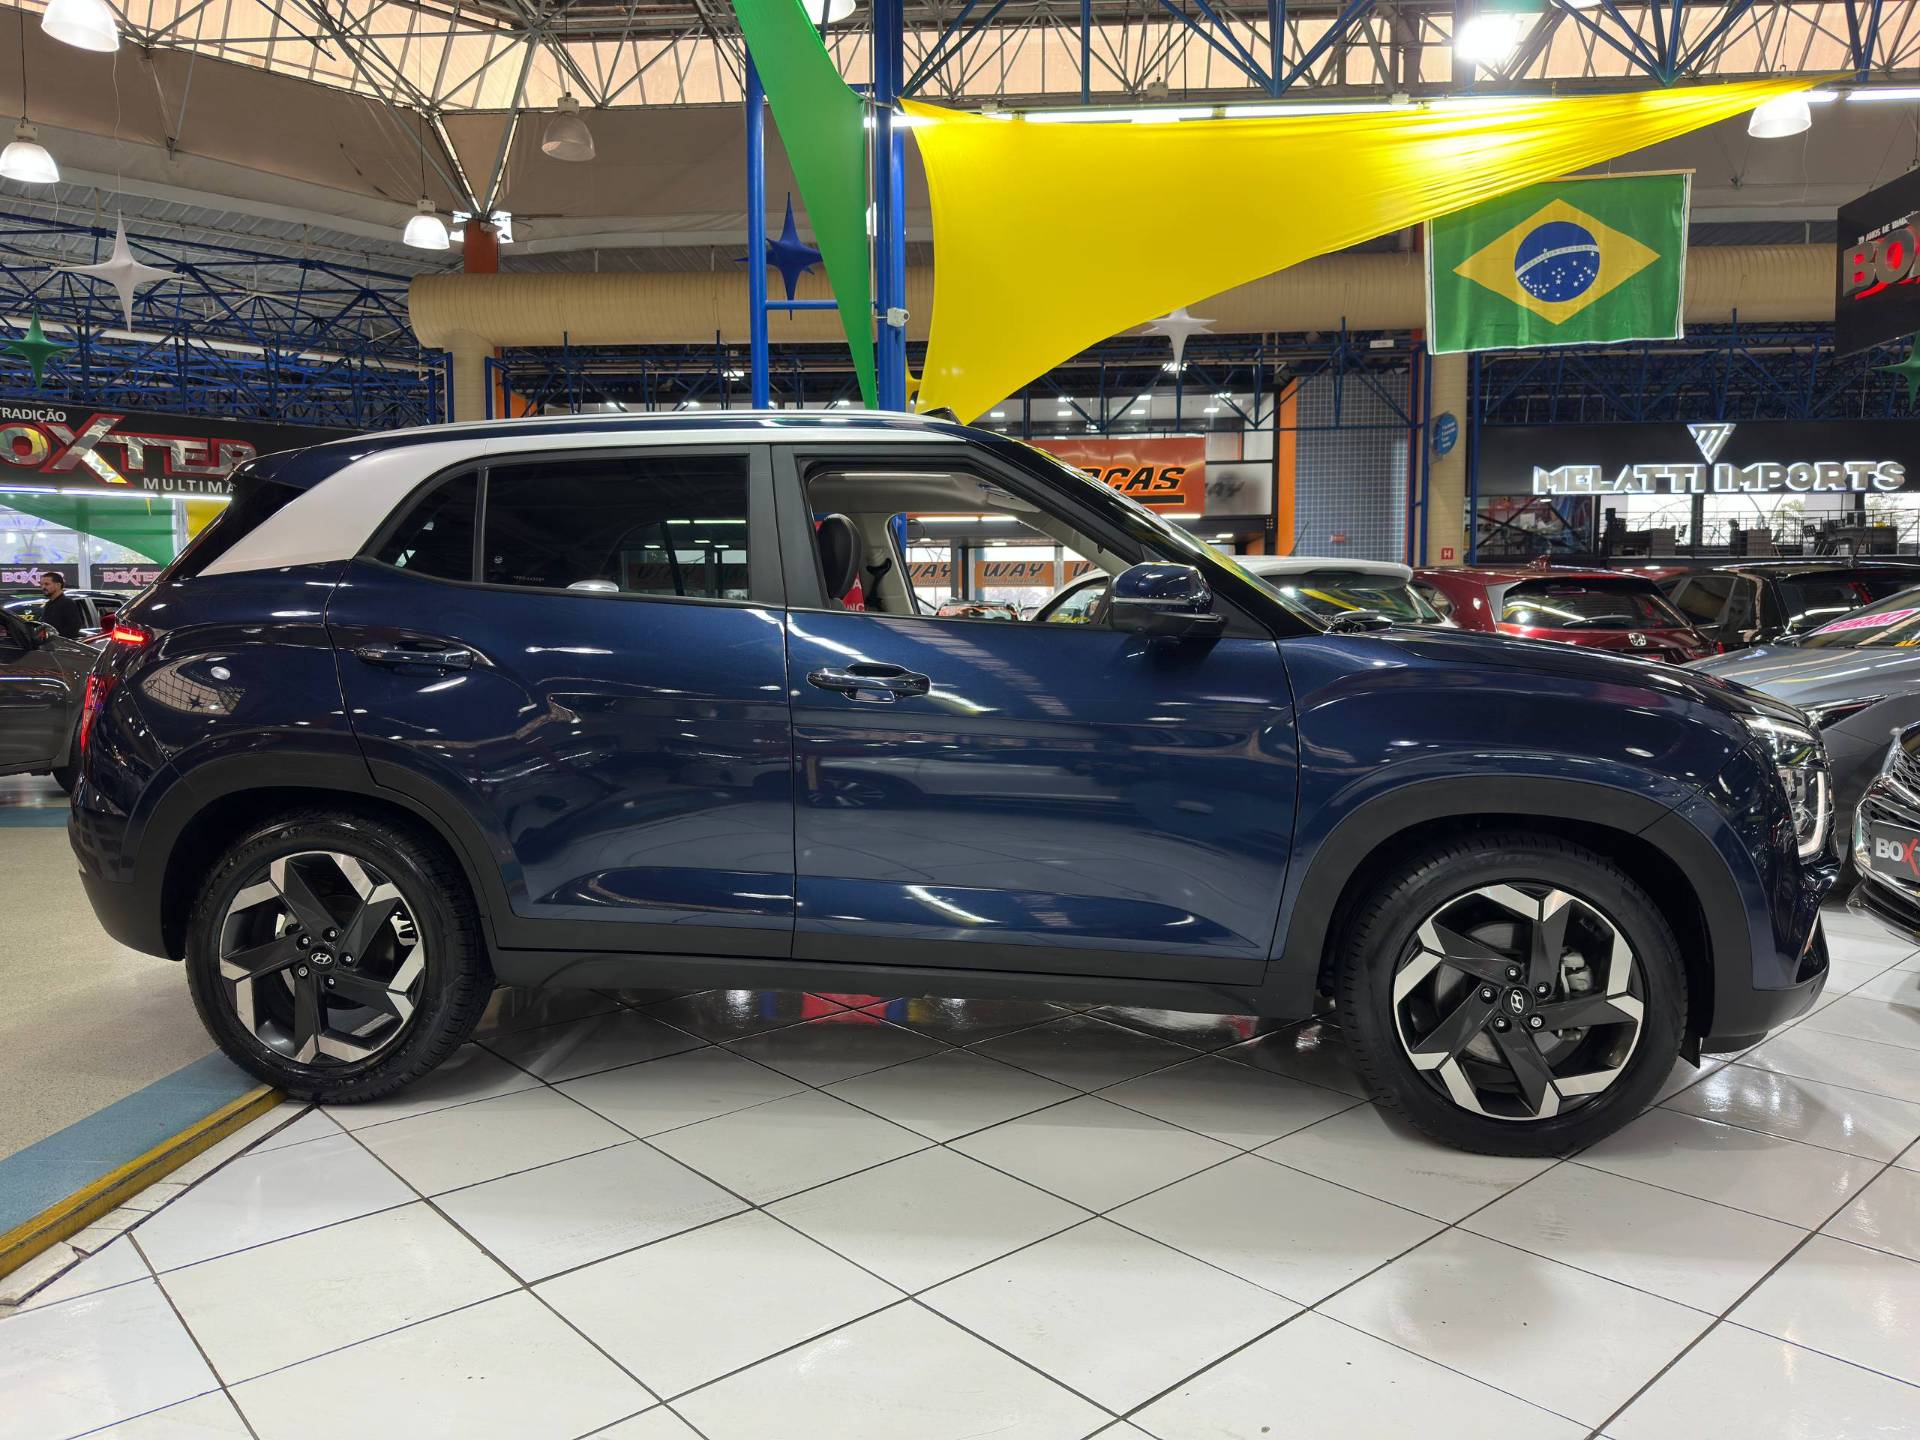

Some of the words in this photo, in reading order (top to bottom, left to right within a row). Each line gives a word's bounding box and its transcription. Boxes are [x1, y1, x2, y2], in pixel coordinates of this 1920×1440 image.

[1533, 464, 1706, 495] MELATTI
[1713, 461, 1906, 492] IMPORTS
[2, 567, 65, 586] BOXT
[103, 567, 160, 586] BOXTE
[983, 563, 1045, 577] WAY
